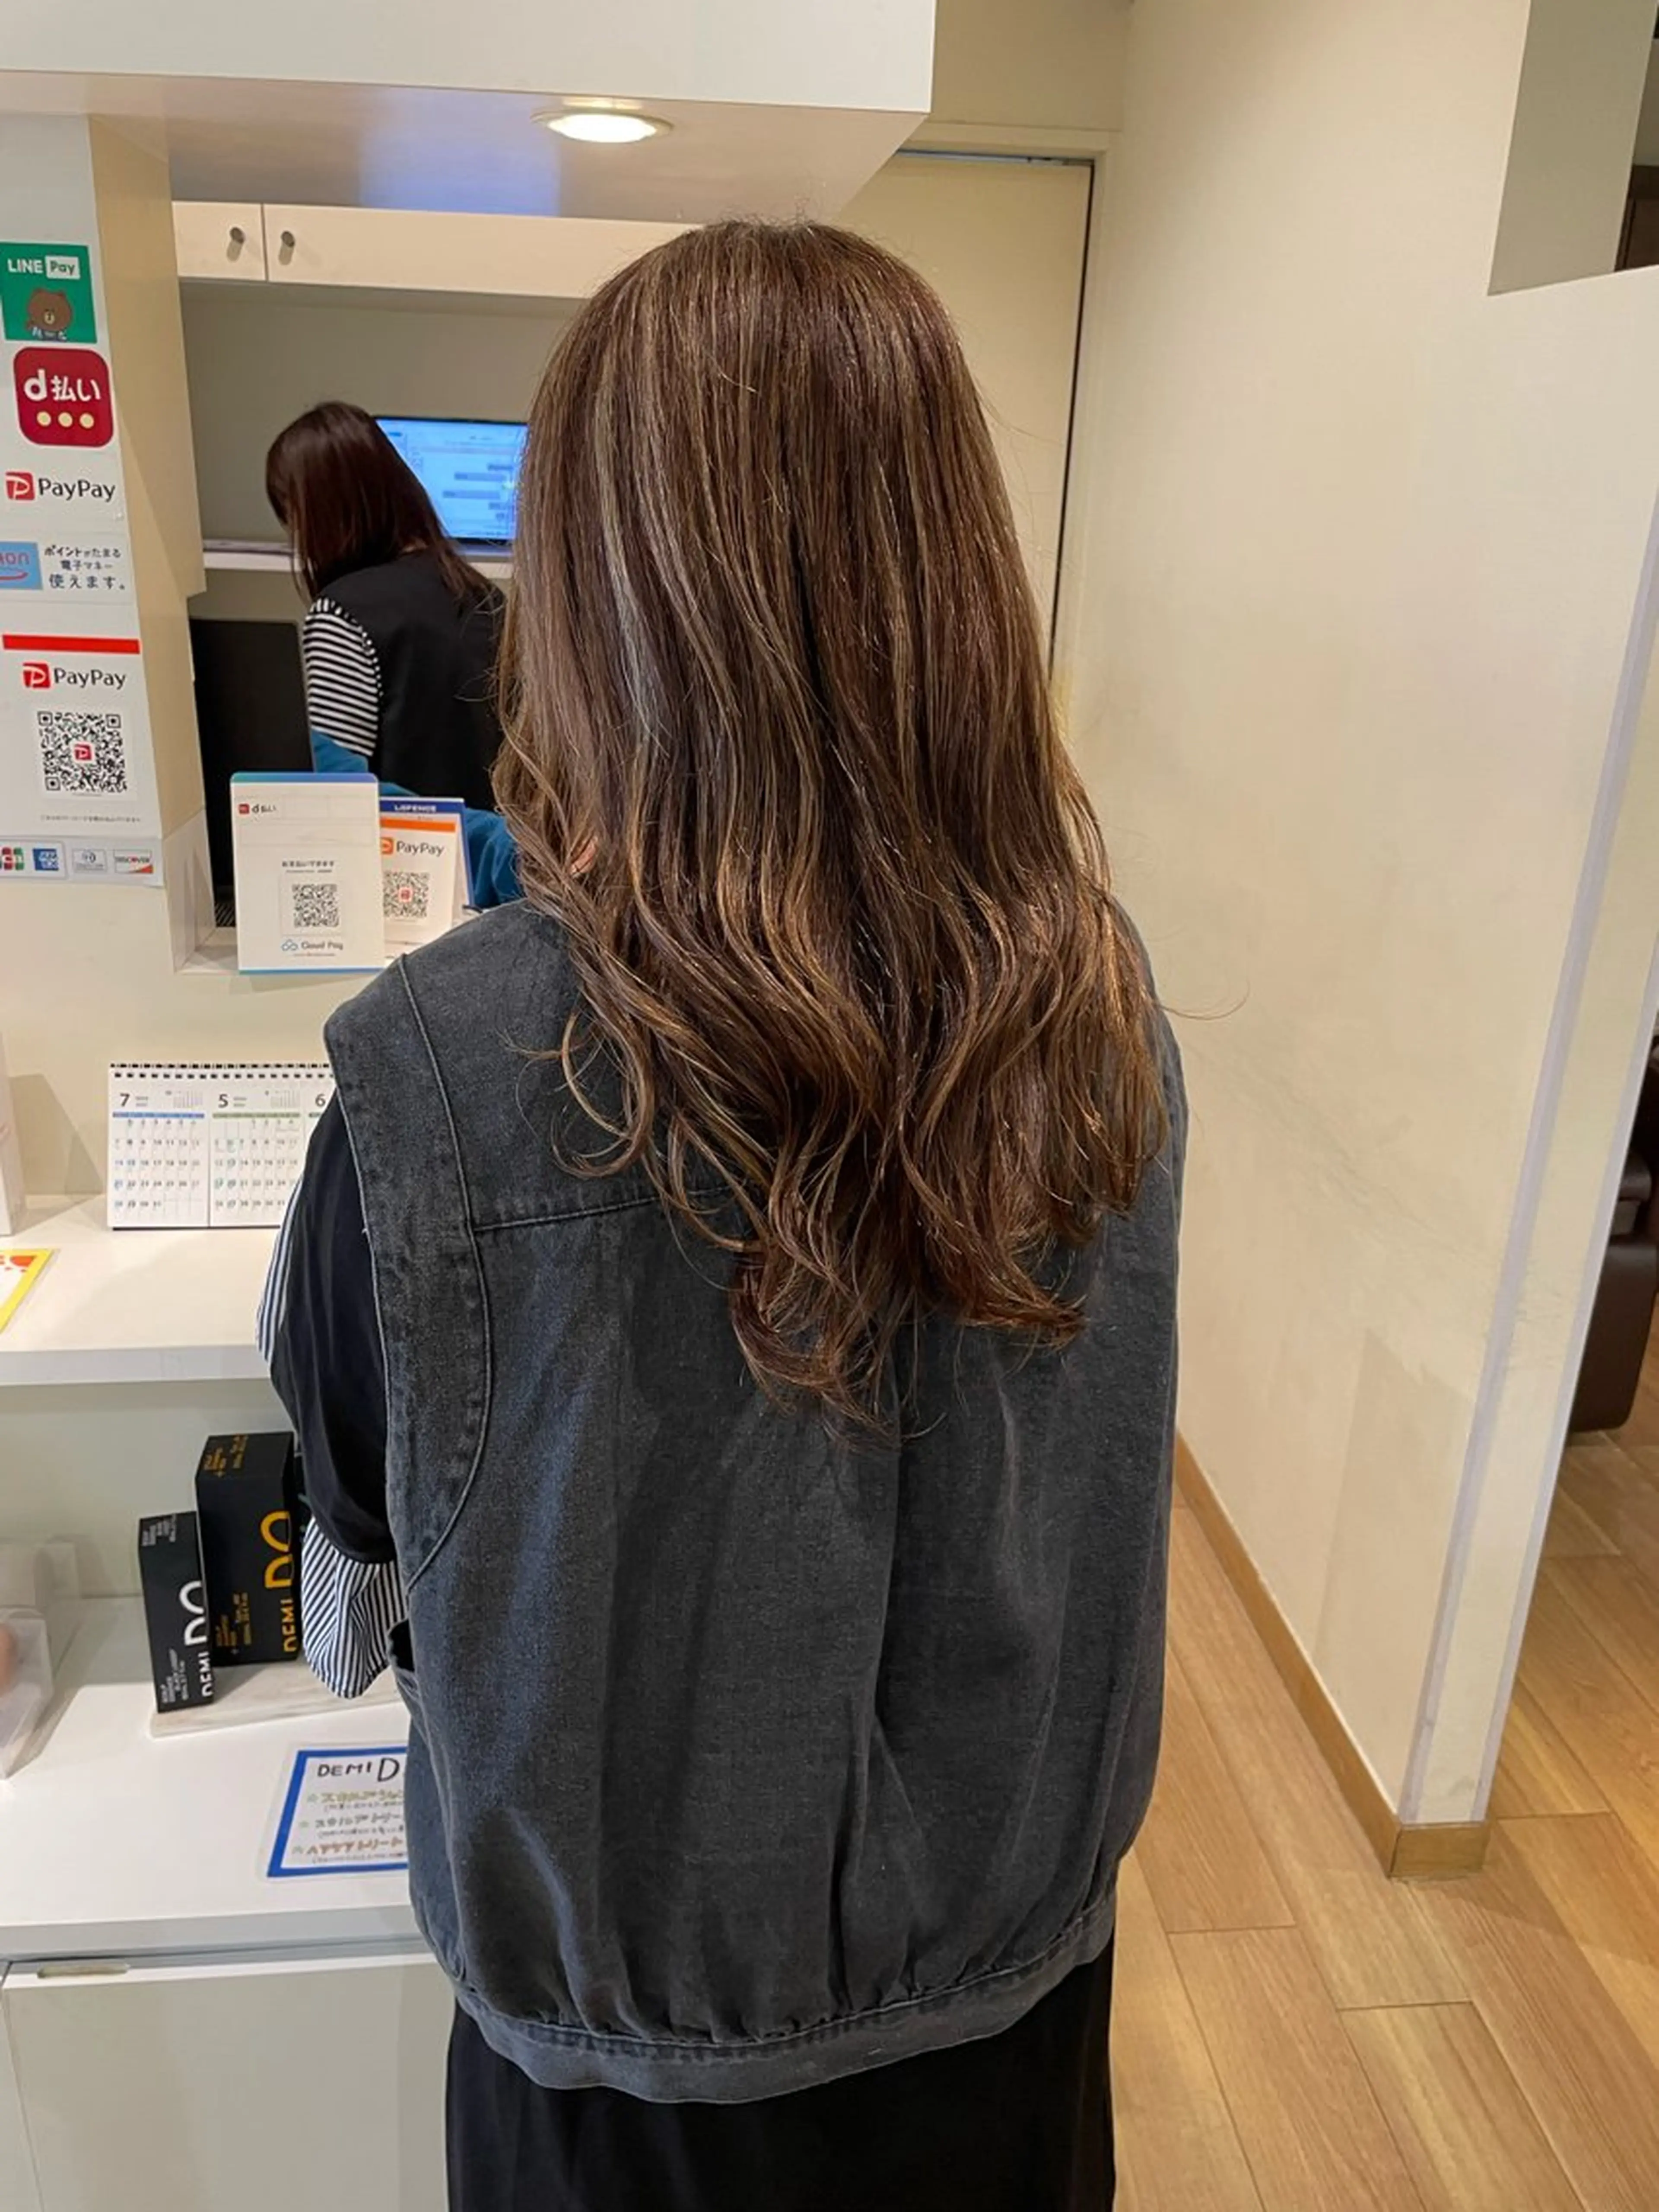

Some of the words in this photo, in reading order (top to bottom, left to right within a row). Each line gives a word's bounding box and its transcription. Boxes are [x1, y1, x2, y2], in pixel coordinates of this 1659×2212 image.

[7, 258, 43, 274] LINE
[50, 260, 75, 275] Pay
[24, 369, 101, 402] d払い
[38, 478, 115, 502] PayPay
[49, 574, 125, 590] 使えます。
[54, 667, 126, 690] PayPay
[397, 840, 444, 857] PayPay
[120, 1093, 130, 1107] 7
[218, 1093, 229, 1108] 5
[315, 1093, 326, 1107] 6
[317, 1761, 372, 1777] DEMI
